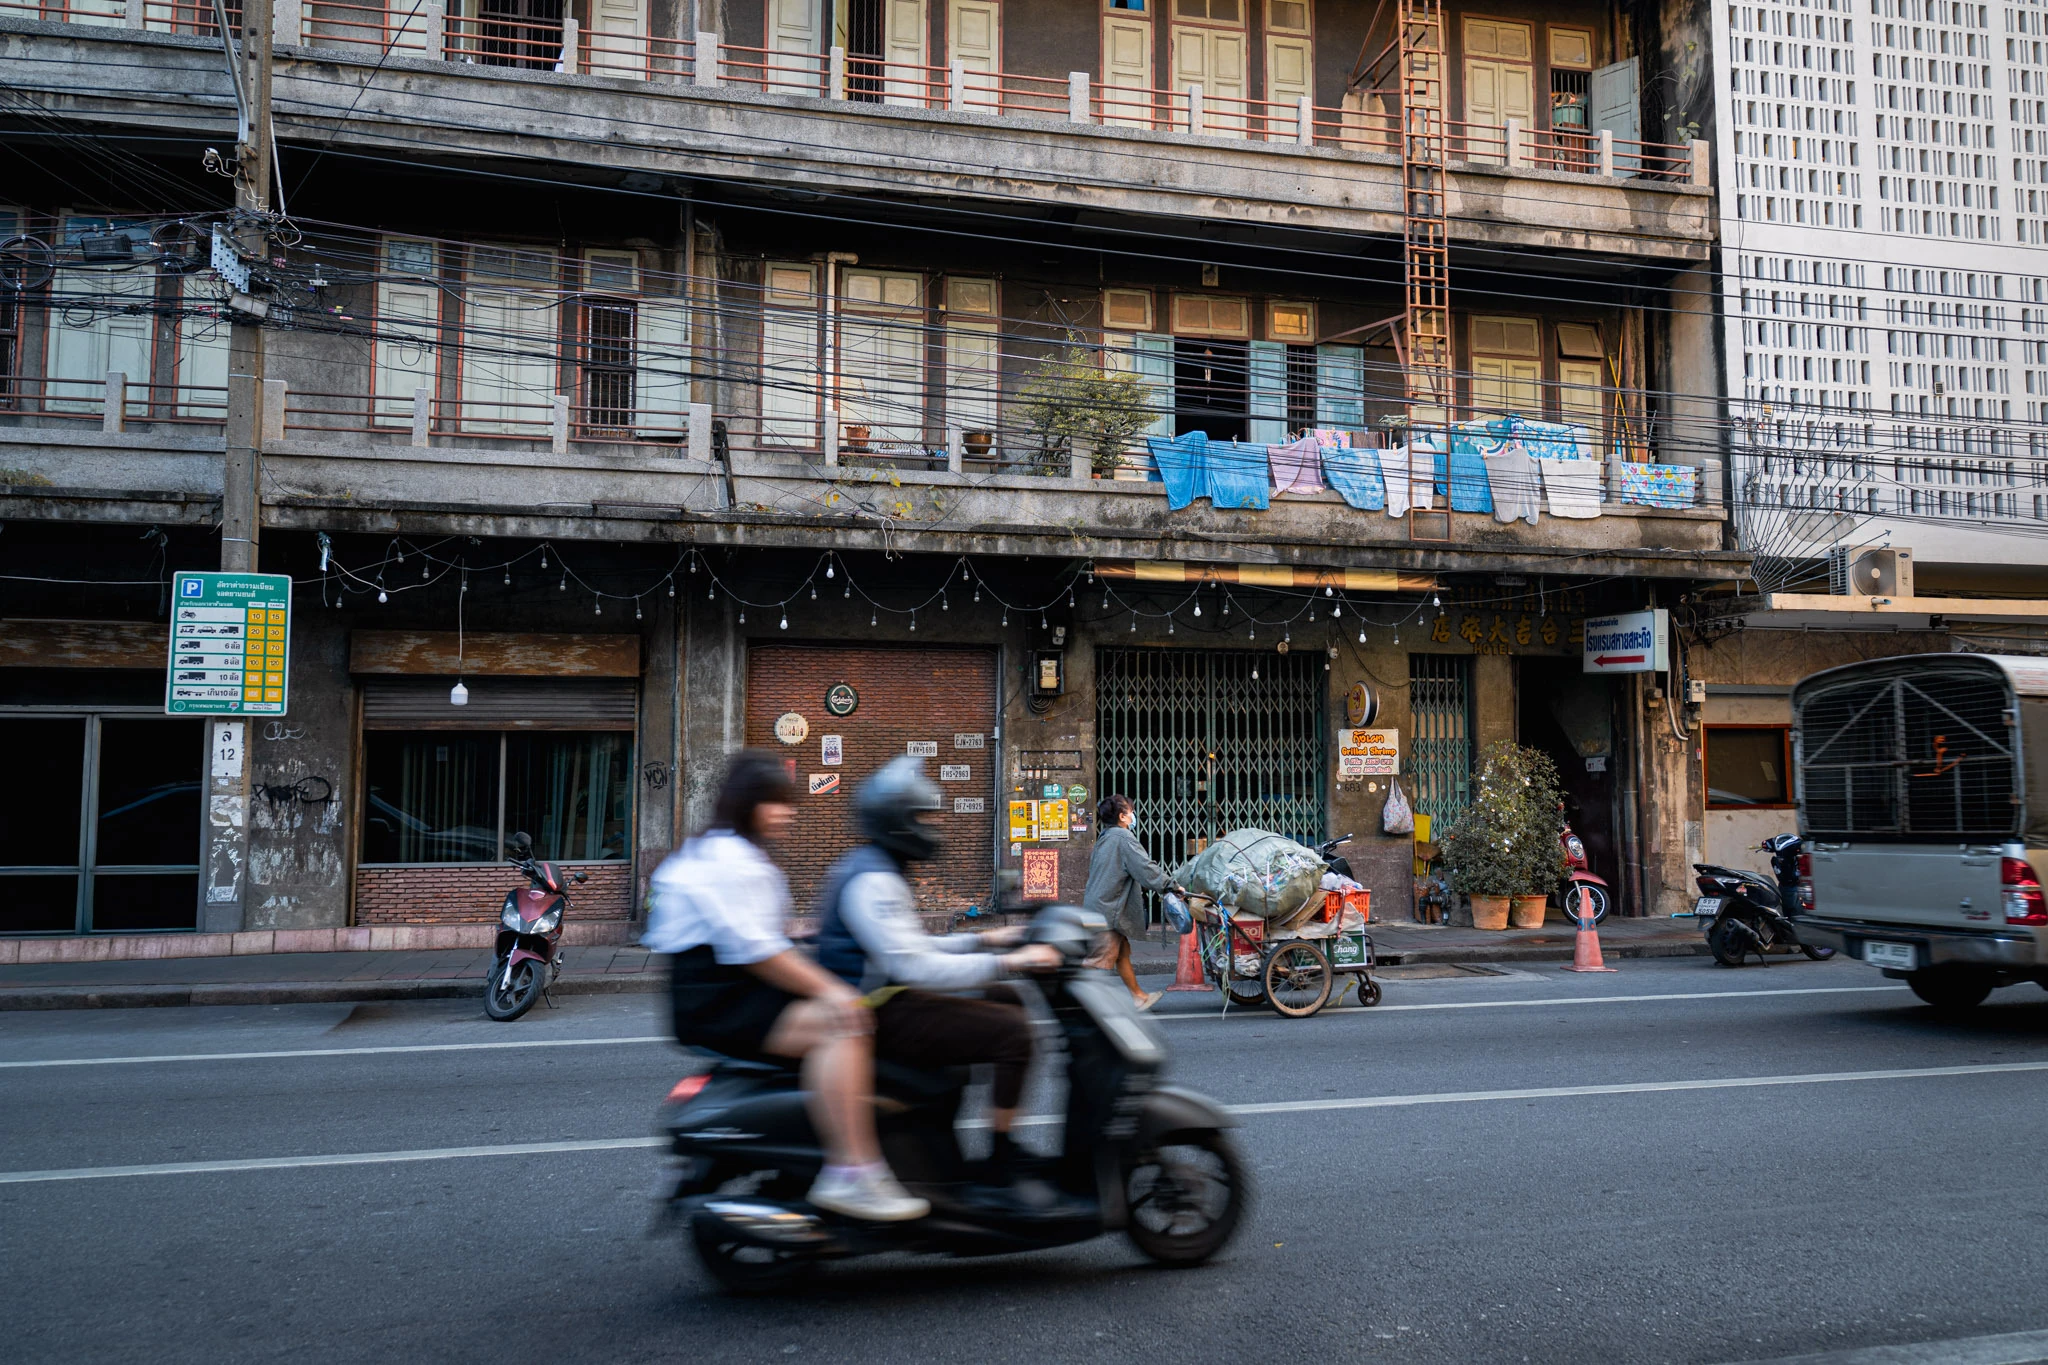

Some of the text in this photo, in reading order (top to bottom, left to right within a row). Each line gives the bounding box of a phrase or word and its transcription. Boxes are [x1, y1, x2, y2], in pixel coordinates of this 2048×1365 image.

[186, 582, 199, 594] P
[1474, 643, 1512, 655] HOTEL
[220, 748, 235, 760] 12
[1341, 746, 1397, 757] Grilled Shrimp
[1344, 783, 1361, 792] 683
[1333, 944, 1358, 955] Chang
